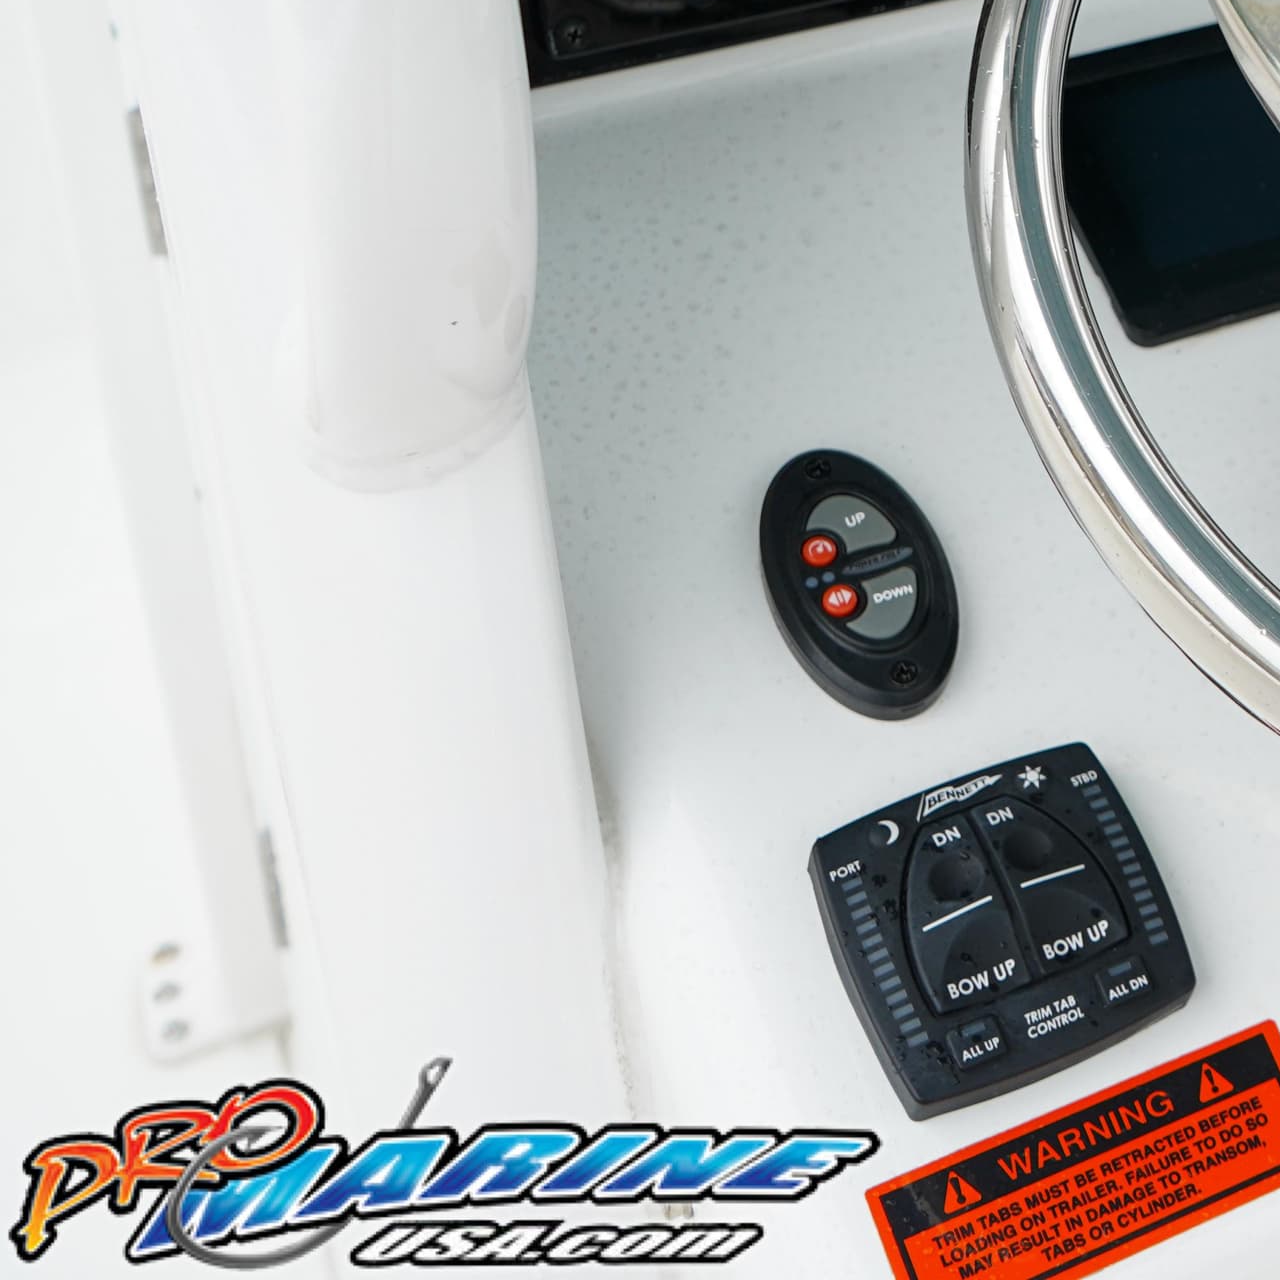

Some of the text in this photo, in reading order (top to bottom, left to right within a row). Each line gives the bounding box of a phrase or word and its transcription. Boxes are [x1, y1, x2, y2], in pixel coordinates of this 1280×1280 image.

[844, 511, 866, 528] UP
[872, 584, 914, 604] DOWN
[925, 775, 989, 807] BENNETT
[1070, 770, 1098, 787] STBD
[985, 806, 1014, 826] DN
[931, 825, 962, 847] DN
[829, 860, 861, 882] PORT
[1042, 919, 1109, 960] BOW UP
[946, 958, 1016, 1000] BOW UP
[1109, 974, 1149, 1001] ALL DN
[1023, 994, 1077, 1025] TRIM TAB
[1027, 1006, 1085, 1039] CONTROL
[962, 1036, 1000, 1062] ALL UP
[997, 1090, 1175, 1181] WARNING
[931, 1096, 1263, 1250] TRIM TABS MUST BE RETRACTED BEFORE
[939, 1112, 1269, 1268] LOADING ON TRAILER. FAILURE TO DO SO
[958, 1134, 1267, 1280] MAY RESULT IN DAMAGE TO TRANSOM,
[1040, 1183, 1202, 1262] TABS OR CYLINDER.
